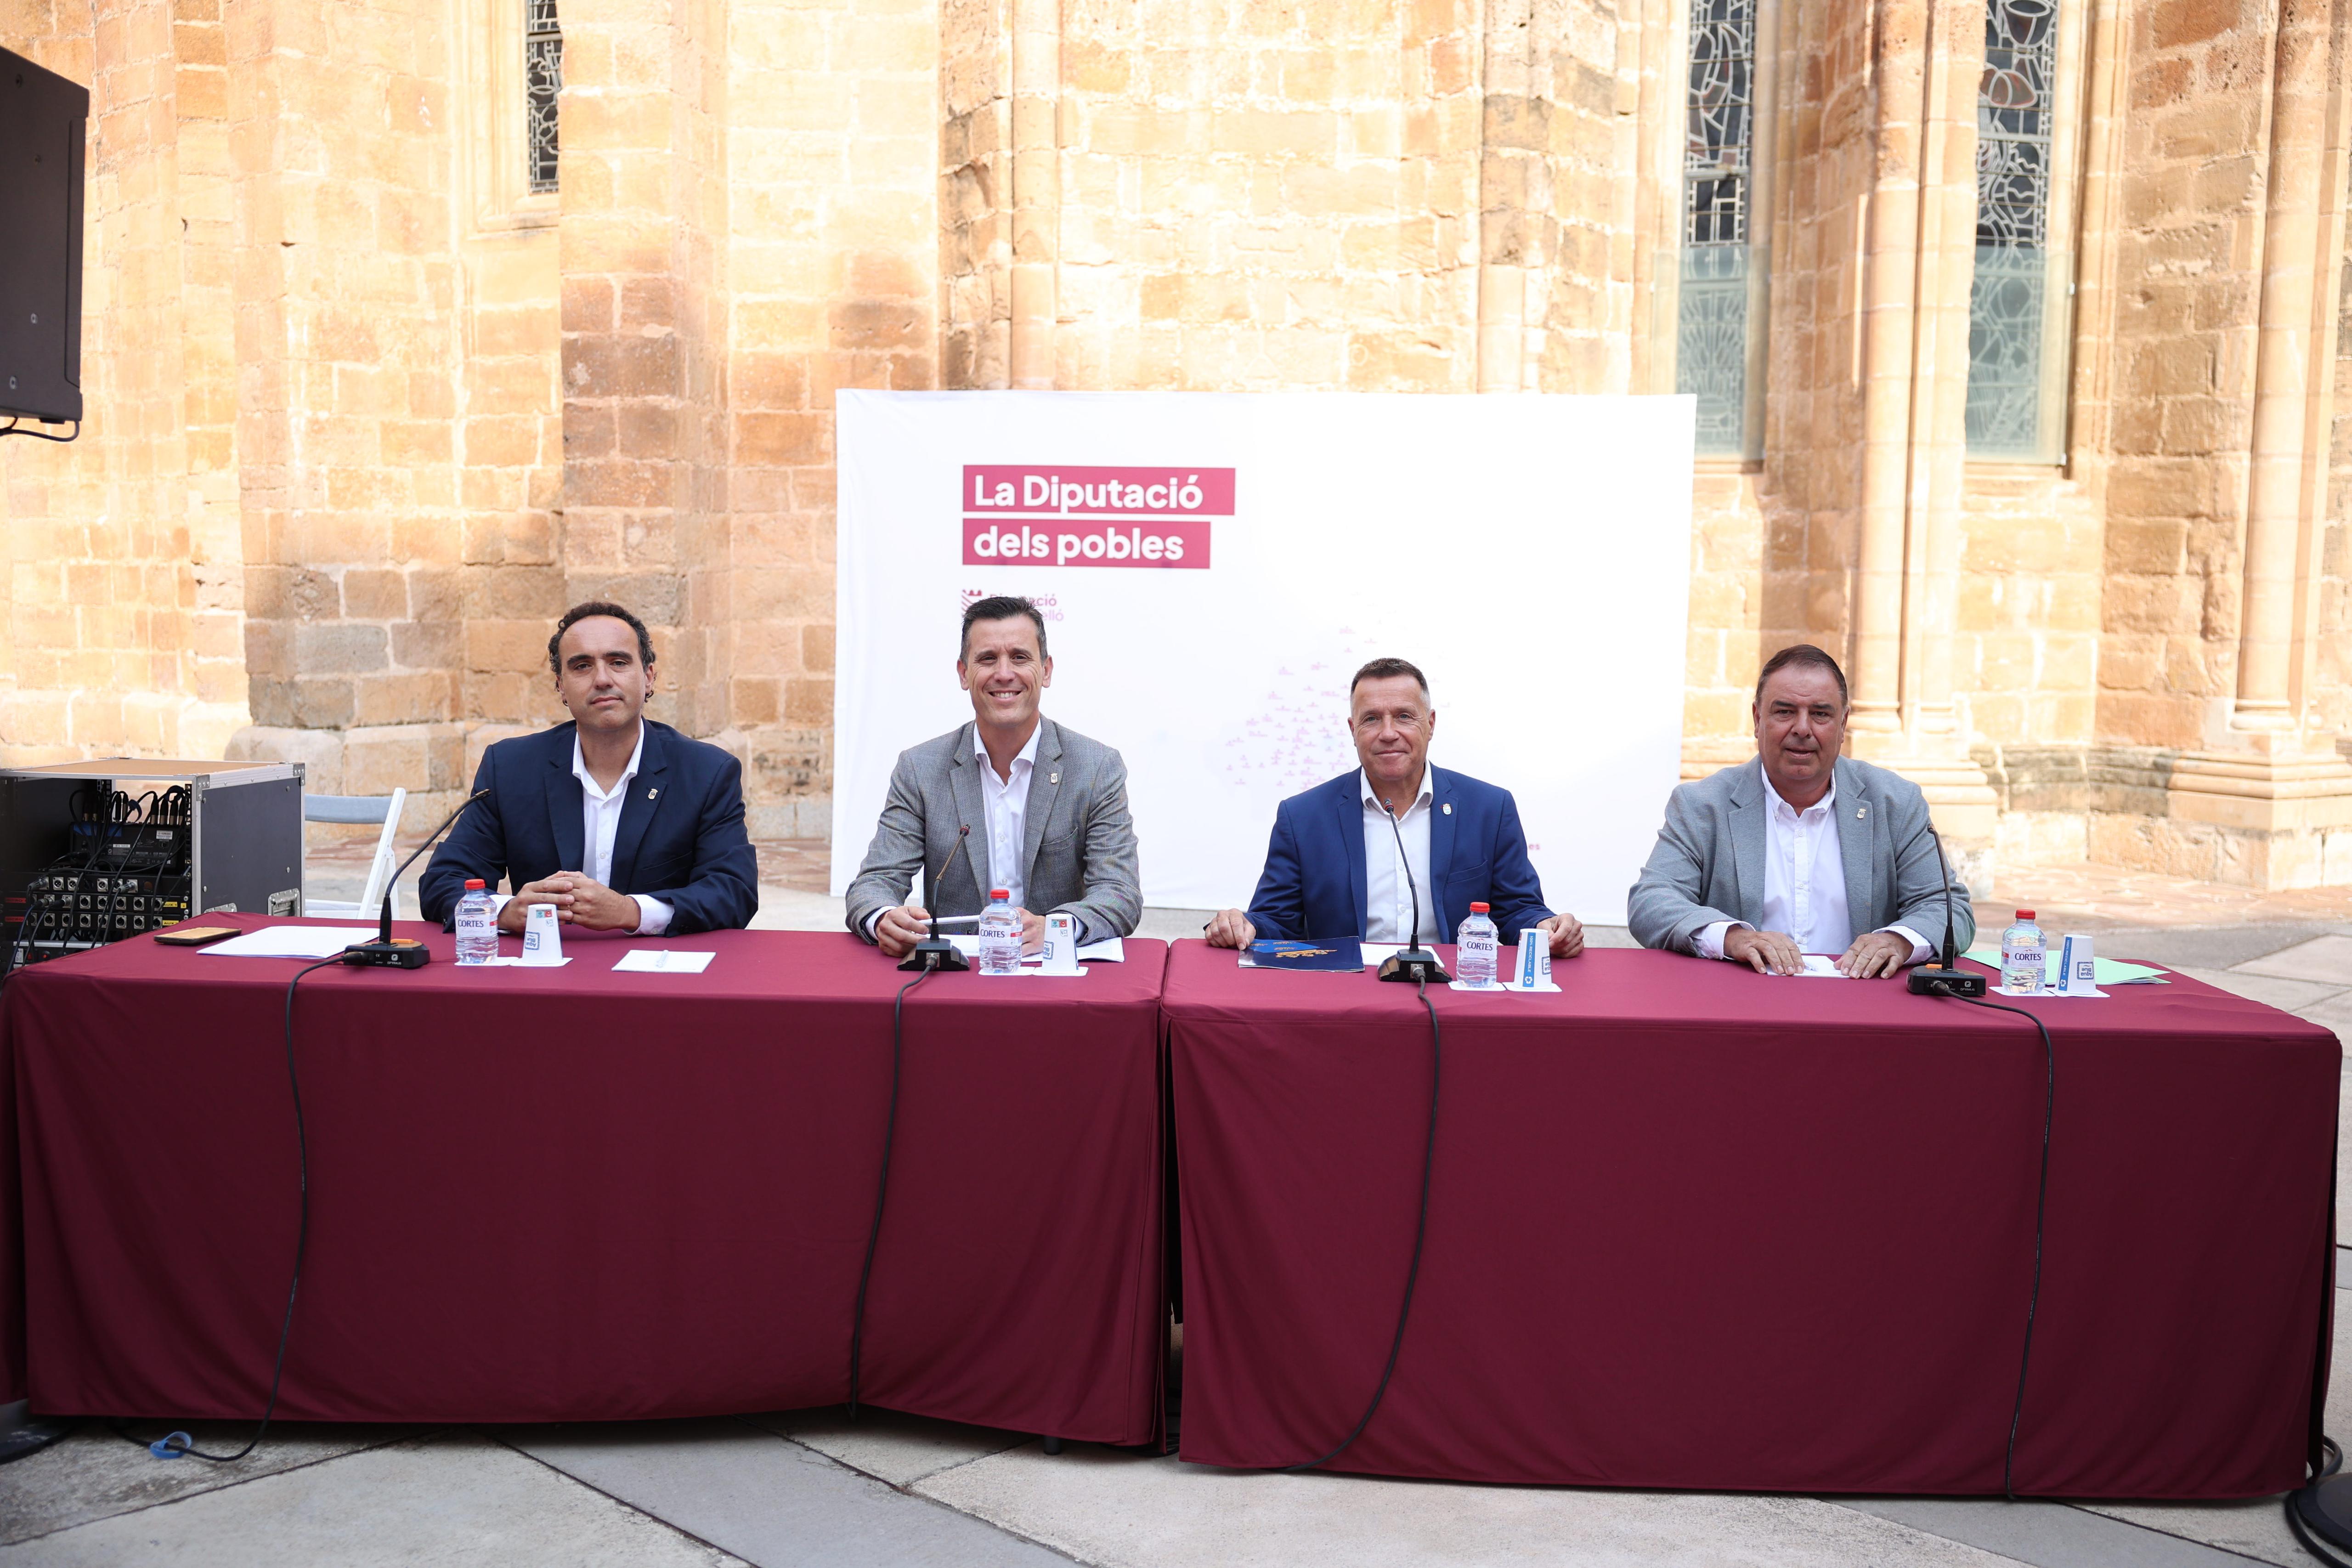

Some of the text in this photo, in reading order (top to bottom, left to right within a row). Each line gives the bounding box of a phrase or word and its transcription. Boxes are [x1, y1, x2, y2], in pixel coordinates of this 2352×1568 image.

[974, 475, 1203, 513] La Diputació
[973, 525, 1184, 565] dels pobles
[980, 929, 1005, 938] CORTES
[1467, 941, 1493, 951] CORTES
[2015, 953, 2041, 961] CORTES
